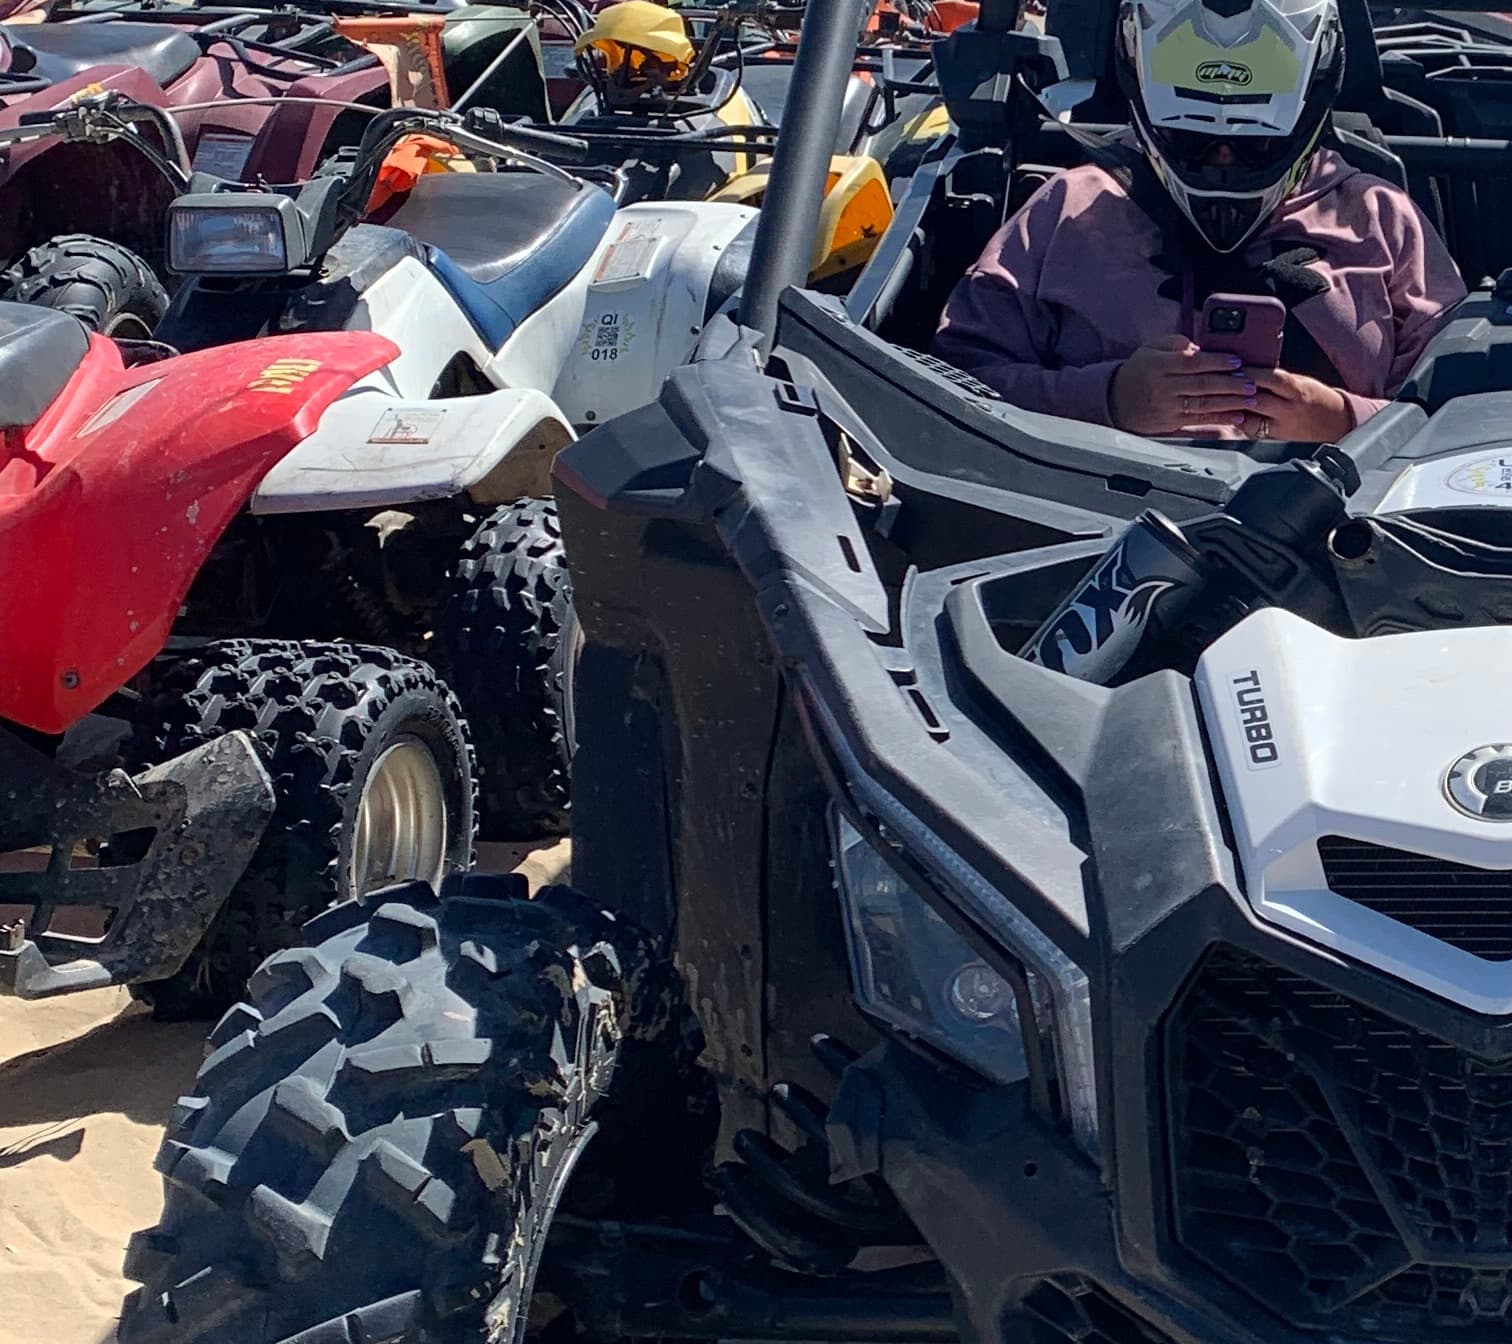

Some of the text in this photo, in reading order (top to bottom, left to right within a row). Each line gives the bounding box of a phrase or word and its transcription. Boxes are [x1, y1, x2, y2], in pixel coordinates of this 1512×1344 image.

[591, 348, 618, 361] 018
[1024, 539, 1135, 678] OX
[1233, 670, 1278, 764] TURBO
